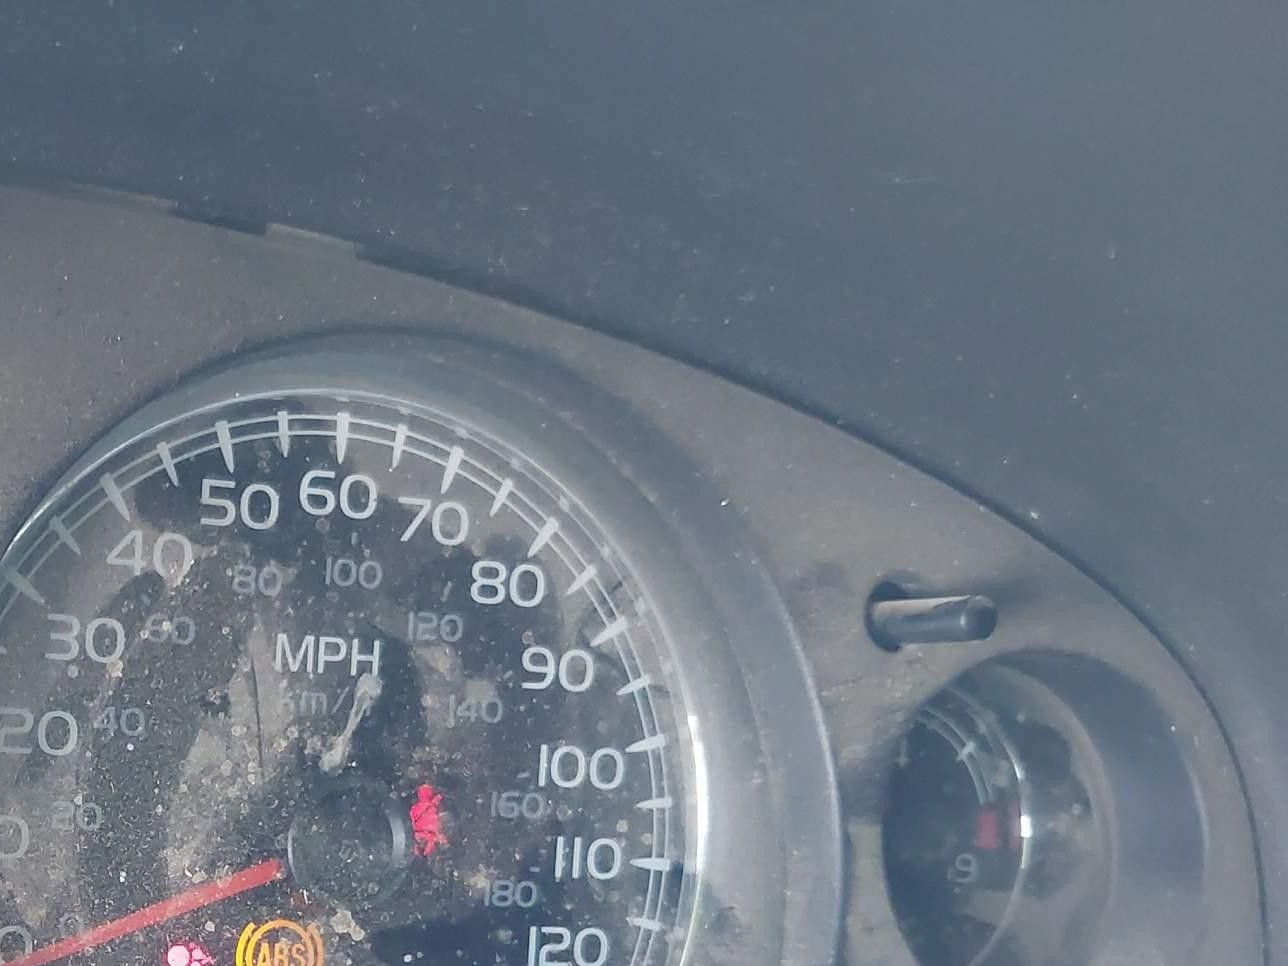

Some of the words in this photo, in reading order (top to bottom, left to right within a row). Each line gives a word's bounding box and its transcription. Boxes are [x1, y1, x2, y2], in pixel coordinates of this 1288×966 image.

[199, 478, 280, 530] 50
[299, 470, 378, 519] 60
[398, 496, 469, 546] 70
[106, 530, 193, 586] 40
[232, 563, 283, 597] 80
[324, 556, 383, 590] 100
[470, 561, 545, 608] 80
[44, 613, 126, 664] 30
[145, 612, 196, 645] 60
[407, 610, 463, 643] 120
[274, 633, 381, 677] MPH
[521, 646, 594, 692] 90
[447, 694, 503, 728] 140
[538, 744, 624, 790] 100
[490, 791, 545, 820] 160
[555, 836, 622, 880] 110
[483, 880, 537, 908] 180
